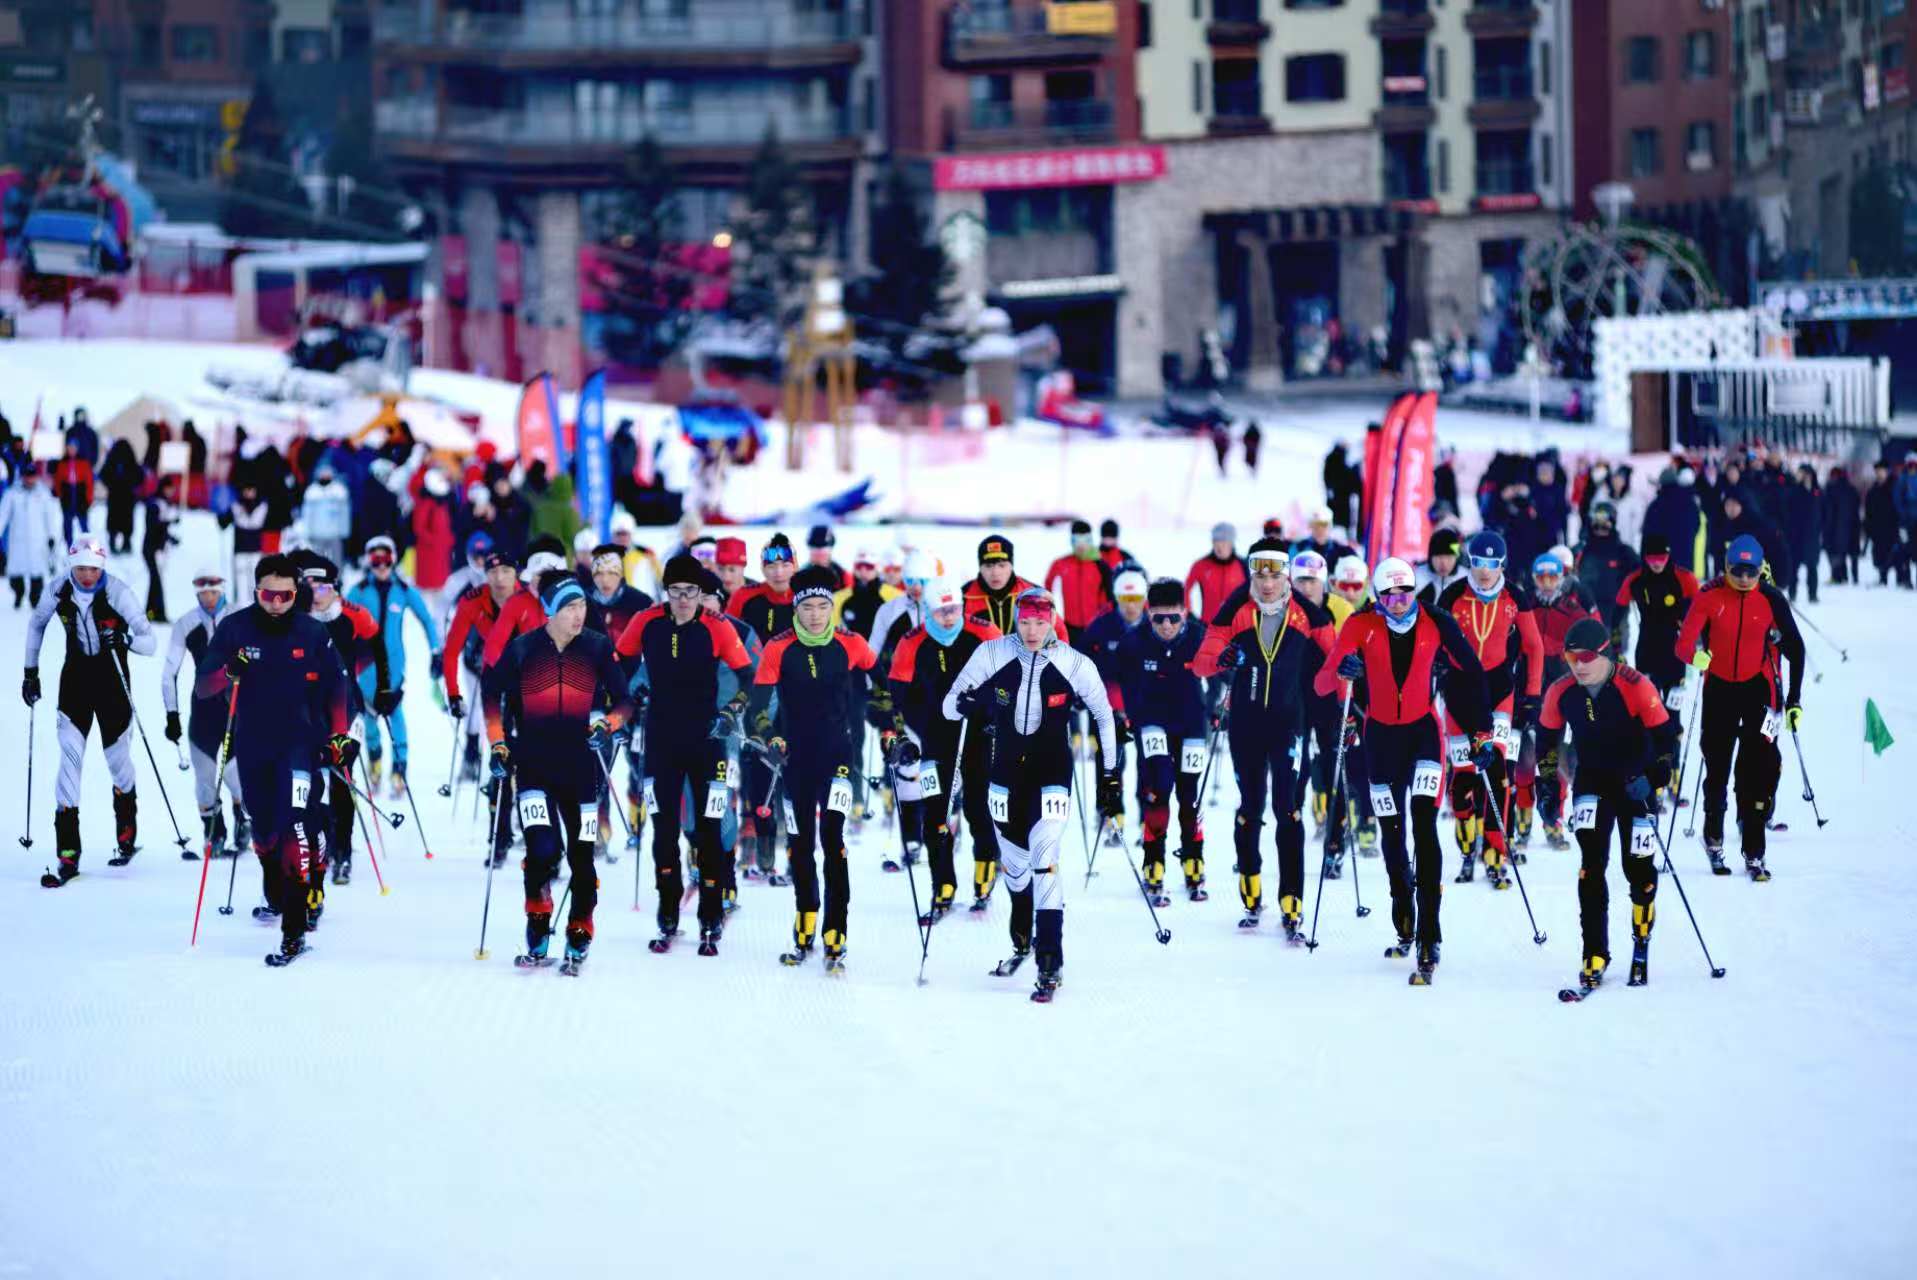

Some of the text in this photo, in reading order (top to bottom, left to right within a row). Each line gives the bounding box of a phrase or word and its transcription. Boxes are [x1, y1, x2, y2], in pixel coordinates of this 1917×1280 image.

[1146, 737, 1165, 753] 121
[1416, 774, 1438, 791] 115
[523, 804, 546, 821] 102
[1045, 798, 1067, 817] 111
